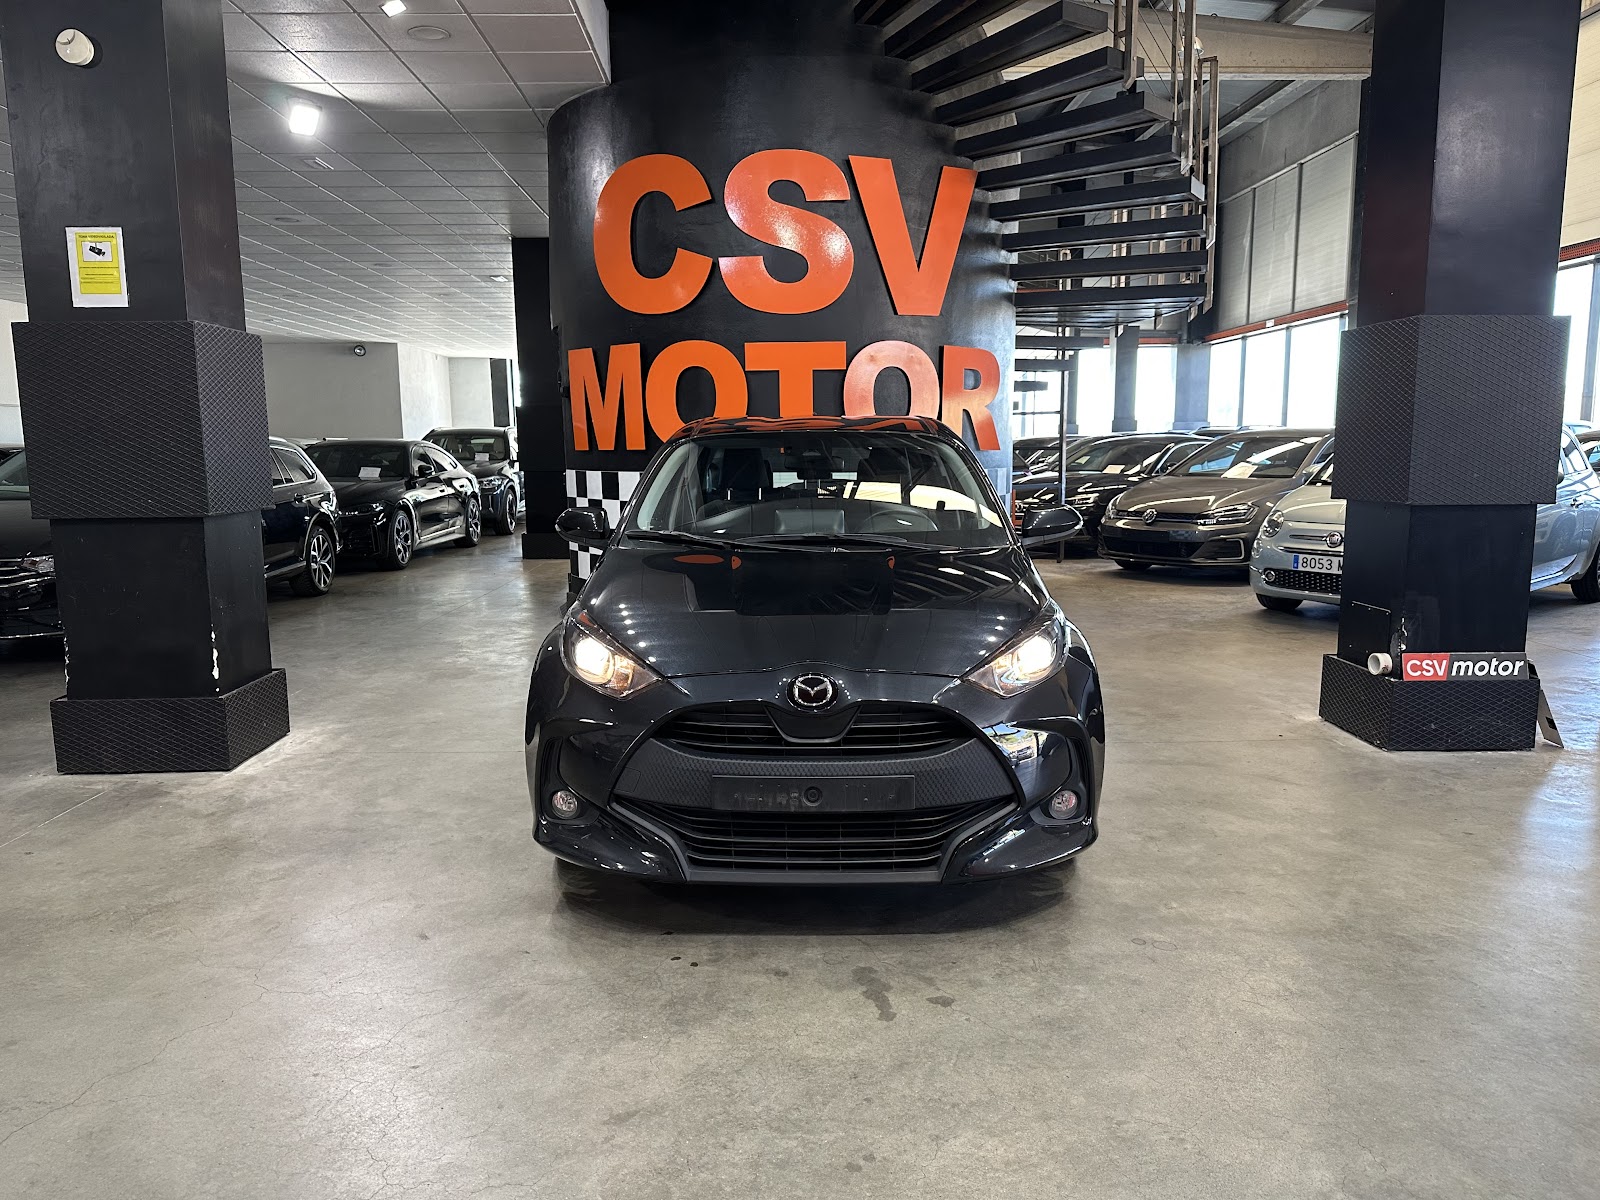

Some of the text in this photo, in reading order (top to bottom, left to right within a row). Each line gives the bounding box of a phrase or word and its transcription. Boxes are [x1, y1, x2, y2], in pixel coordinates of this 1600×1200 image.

[593, 149, 978, 316] CSV
[568, 340, 1000, 450] MOTOR
[1301, 556, 1333, 571] 8053
[1406, 657, 1524, 677] CSV motor
